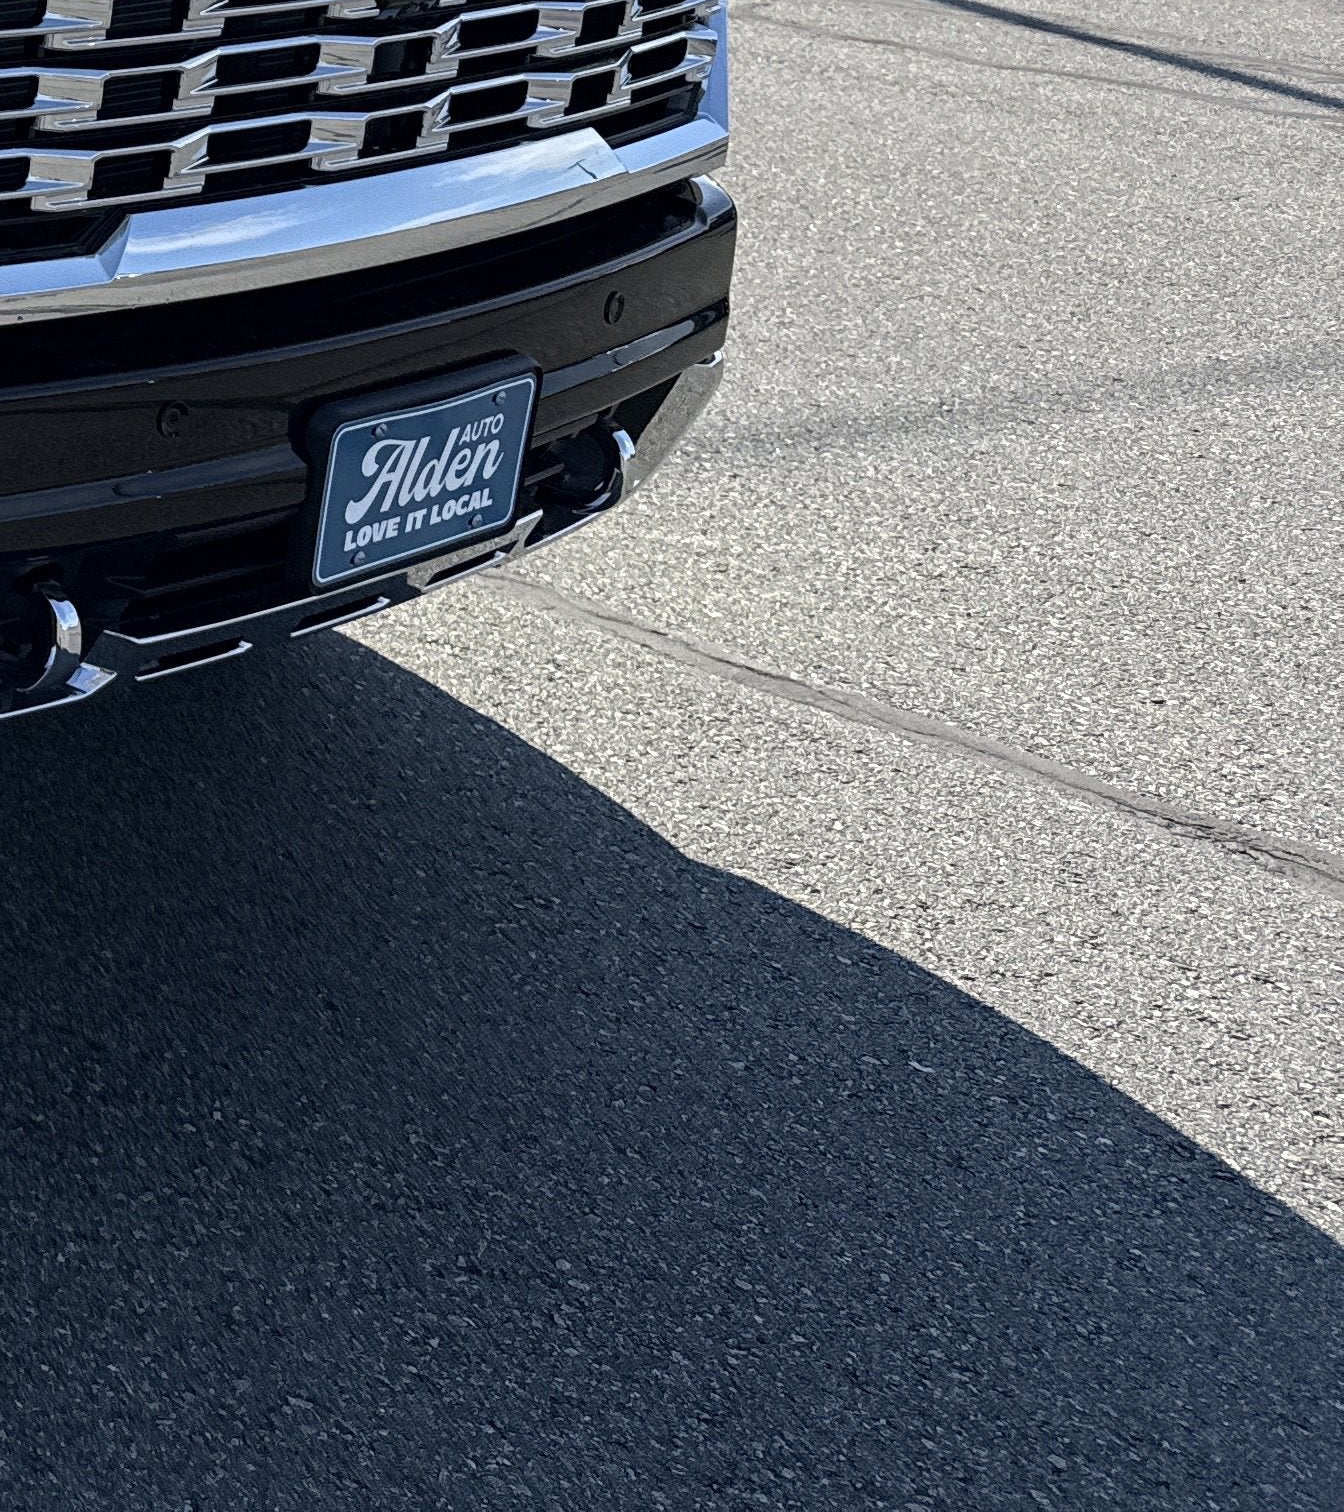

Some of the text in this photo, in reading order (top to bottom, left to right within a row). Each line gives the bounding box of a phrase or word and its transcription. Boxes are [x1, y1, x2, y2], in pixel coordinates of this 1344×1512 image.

[458, 413, 504, 446] AUTO
[344, 426, 504, 525] Alden
[343, 487, 493, 552] LOVE IT LOCAL
